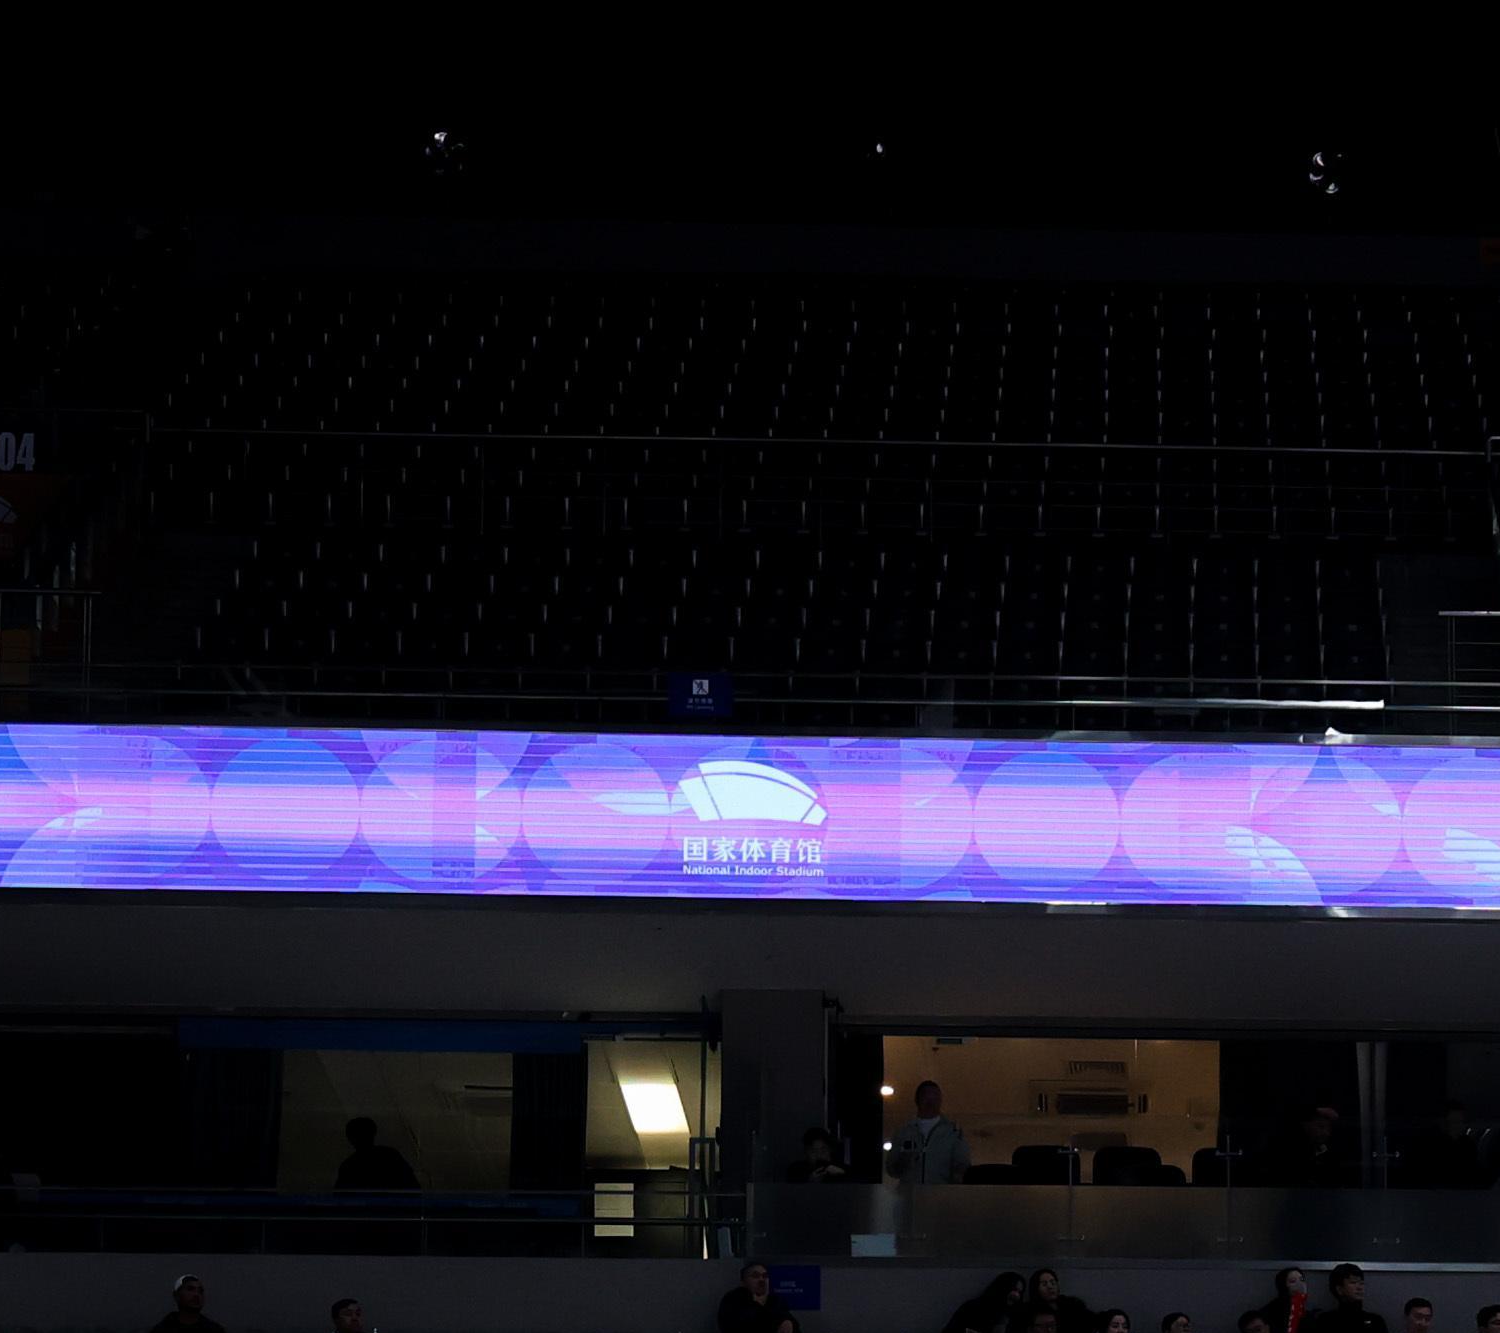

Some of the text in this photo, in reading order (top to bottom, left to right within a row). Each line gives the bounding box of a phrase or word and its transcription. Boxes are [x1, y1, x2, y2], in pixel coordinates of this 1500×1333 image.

[680, 835, 824, 865] 国家体育馆
[681, 863, 825, 880] National Indoor Stadium
